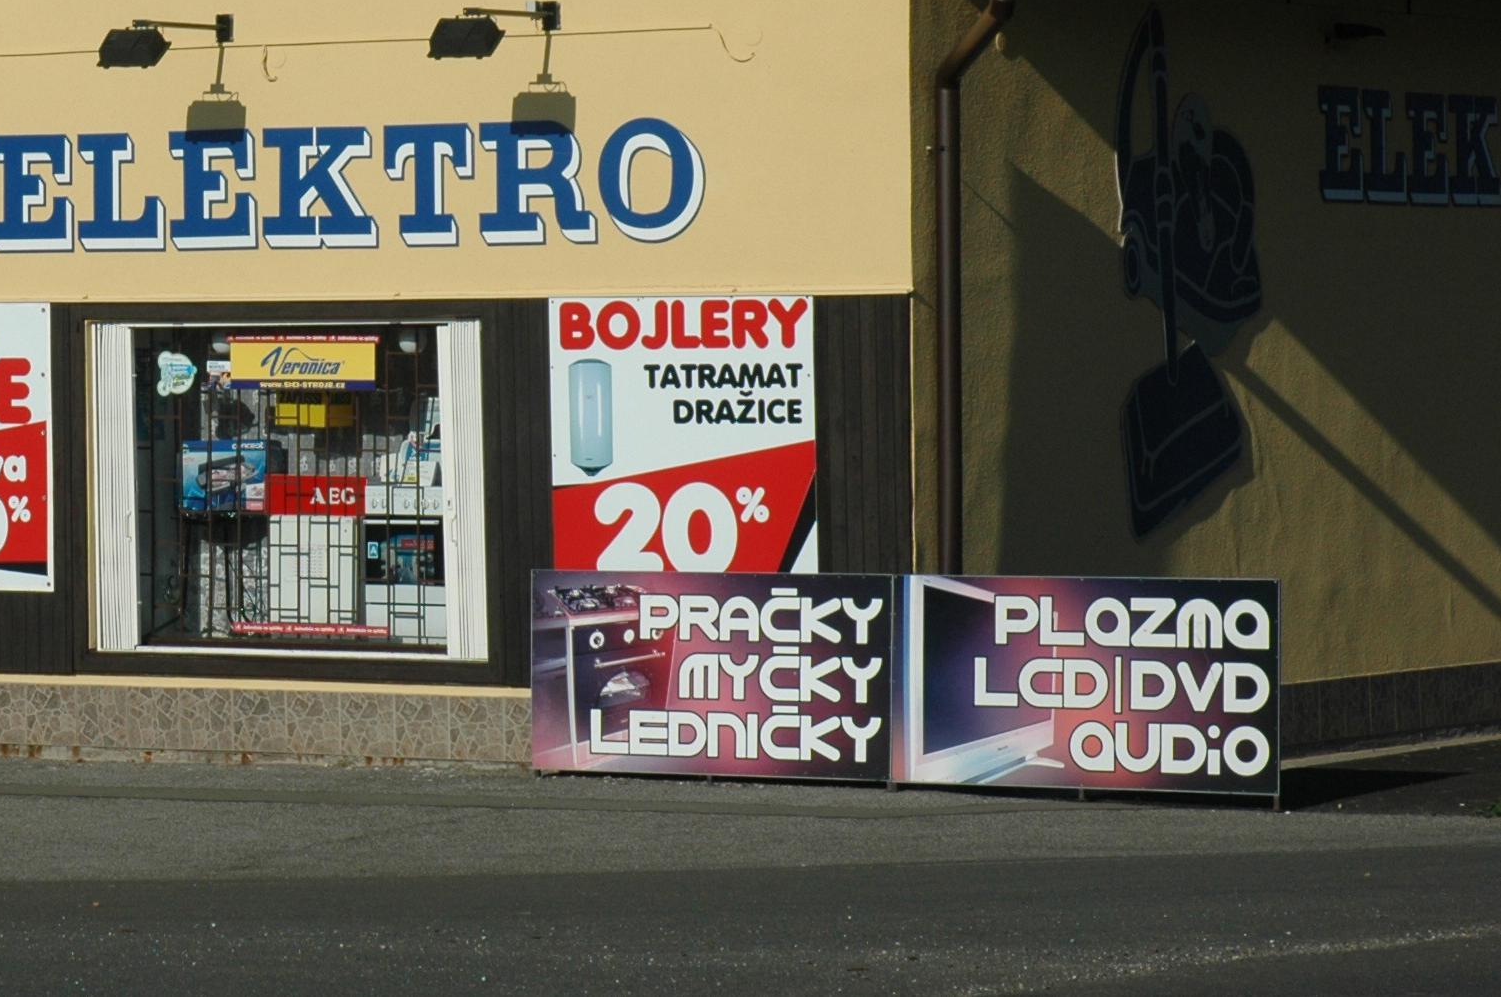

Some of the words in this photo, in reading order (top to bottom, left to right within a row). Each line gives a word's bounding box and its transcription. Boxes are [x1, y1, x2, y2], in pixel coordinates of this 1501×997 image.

[1318, 85, 1501, 207] ELEK
[559, 298, 808, 350] BOJLERY
[260, 346, 342, 377] Veronica
[644, 363, 803, 389] TATRAMAT
[673, 391, 803, 424] DRAŽICE
[309, 486, 356, 505] AEG
[594, 481, 770, 573] 20%
[638, 587, 884, 644] PRAČKY
[994, 594, 1271, 650] PLAZMA
[678, 646, 884, 704] MYČKY
[590, 705, 883, 764] LEDNIČKY
